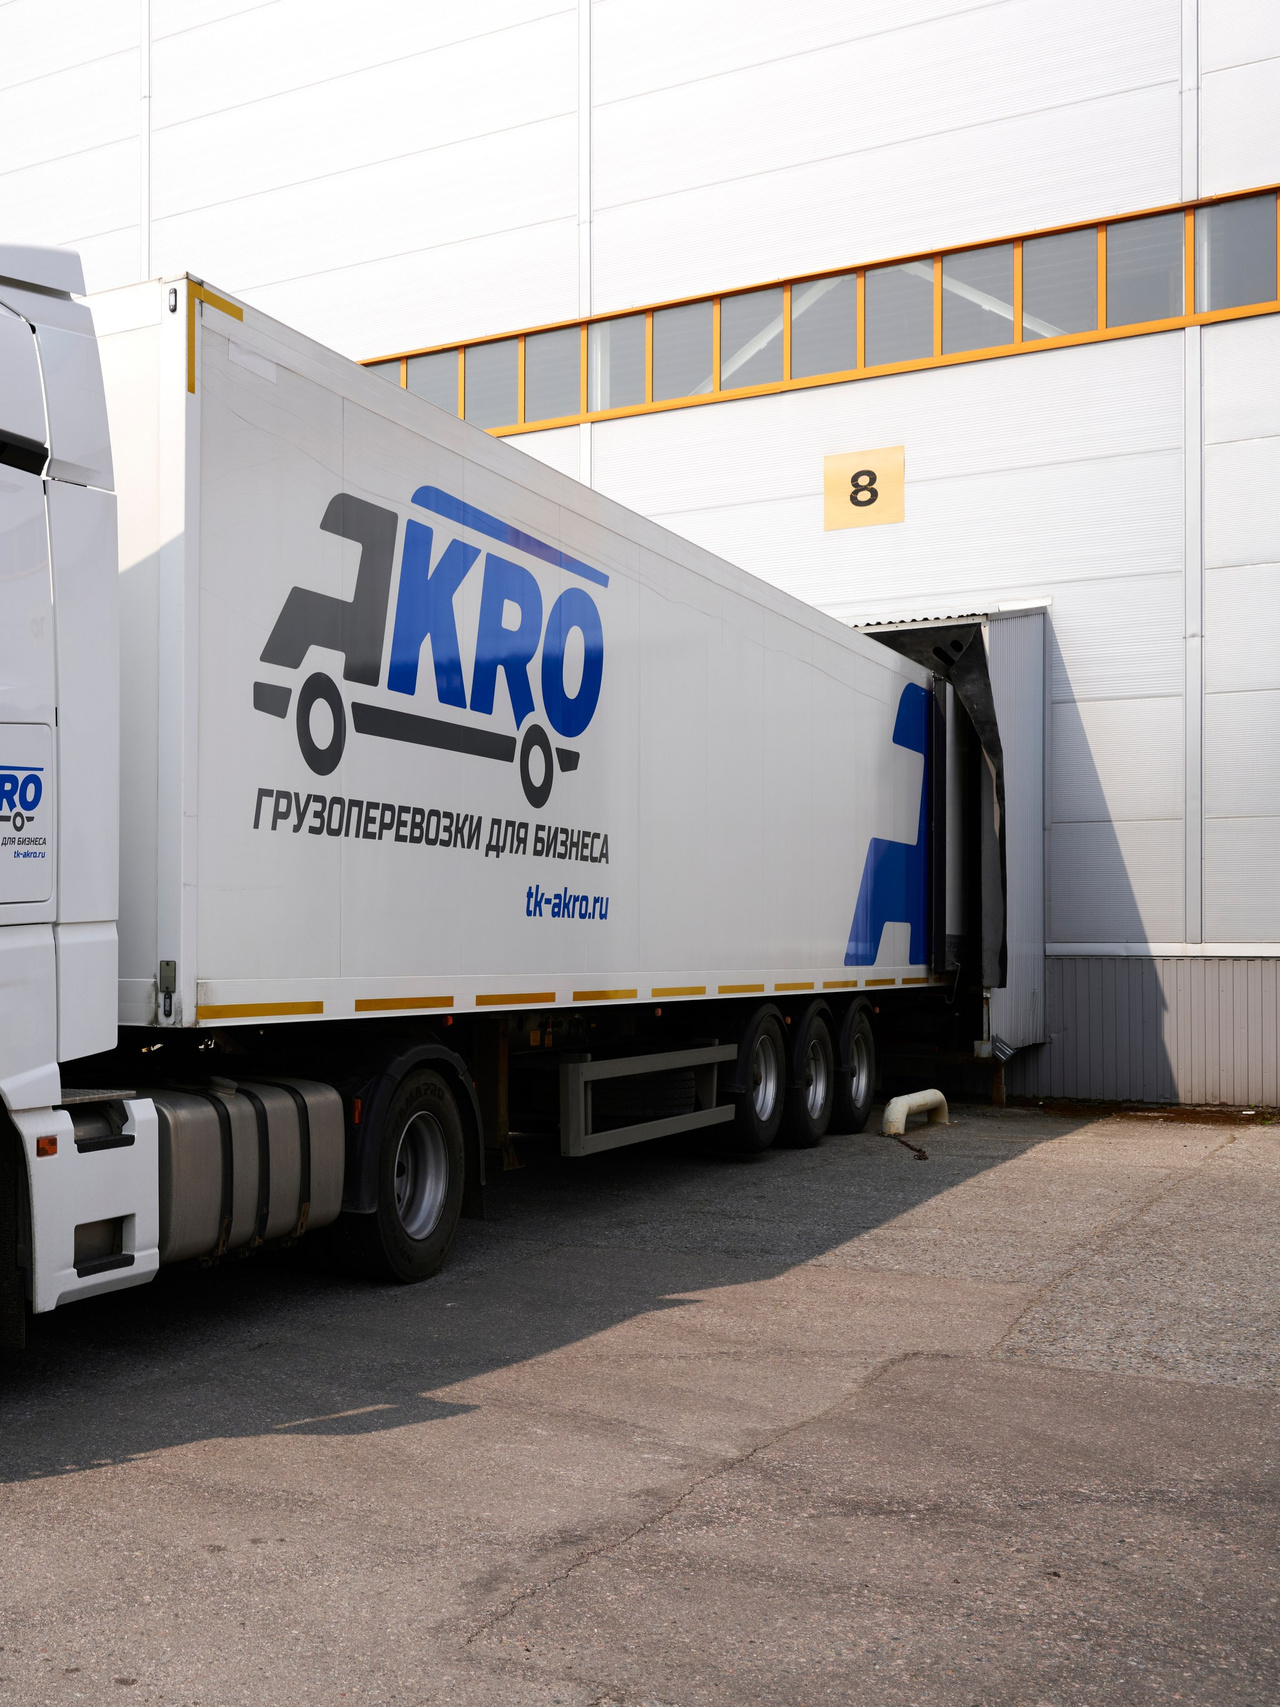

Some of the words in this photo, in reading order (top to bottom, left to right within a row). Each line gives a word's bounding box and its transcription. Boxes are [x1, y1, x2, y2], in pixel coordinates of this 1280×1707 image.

[849, 469, 879, 507] 8
[259, 492, 604, 738] AKRO
[1, 837, 16, 846] ДЛЯ
[17, 837, 46, 846] БИЗНЕСА
[253, 788, 482, 850] ГРУЗОПЕРЕВОЗКИ
[484, 818, 529, 858] ДЛЯ
[533, 824, 610, 864] БИЗНЕСА
[13, 850, 46, 858] tk-akro.ru
[525, 884, 609, 920] tk-akro.ru
